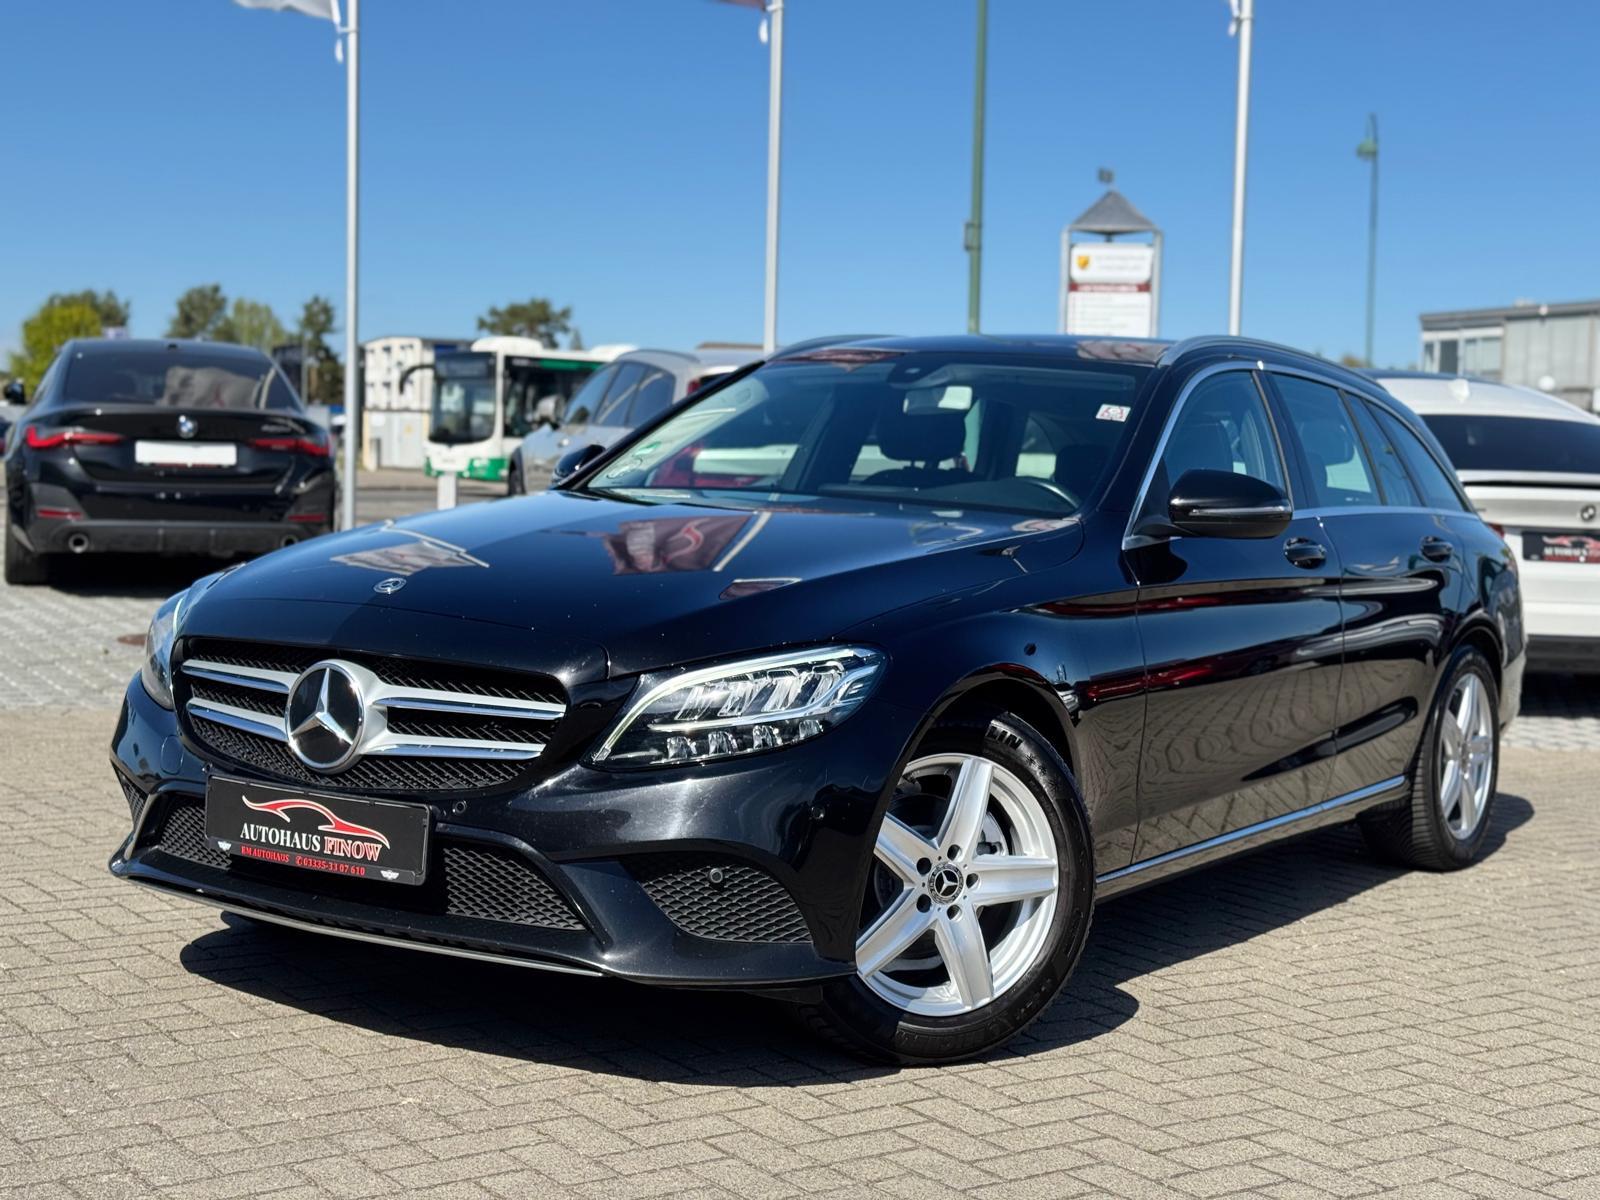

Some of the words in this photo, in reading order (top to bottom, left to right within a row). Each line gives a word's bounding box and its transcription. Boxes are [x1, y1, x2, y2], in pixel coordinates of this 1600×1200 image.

[240, 823, 321, 852] AUTOHAUS
[323, 836, 382, 862] FINOW
[252, 848, 290, 863] AUTOHAUS
[351, 865, 366, 876] 610
